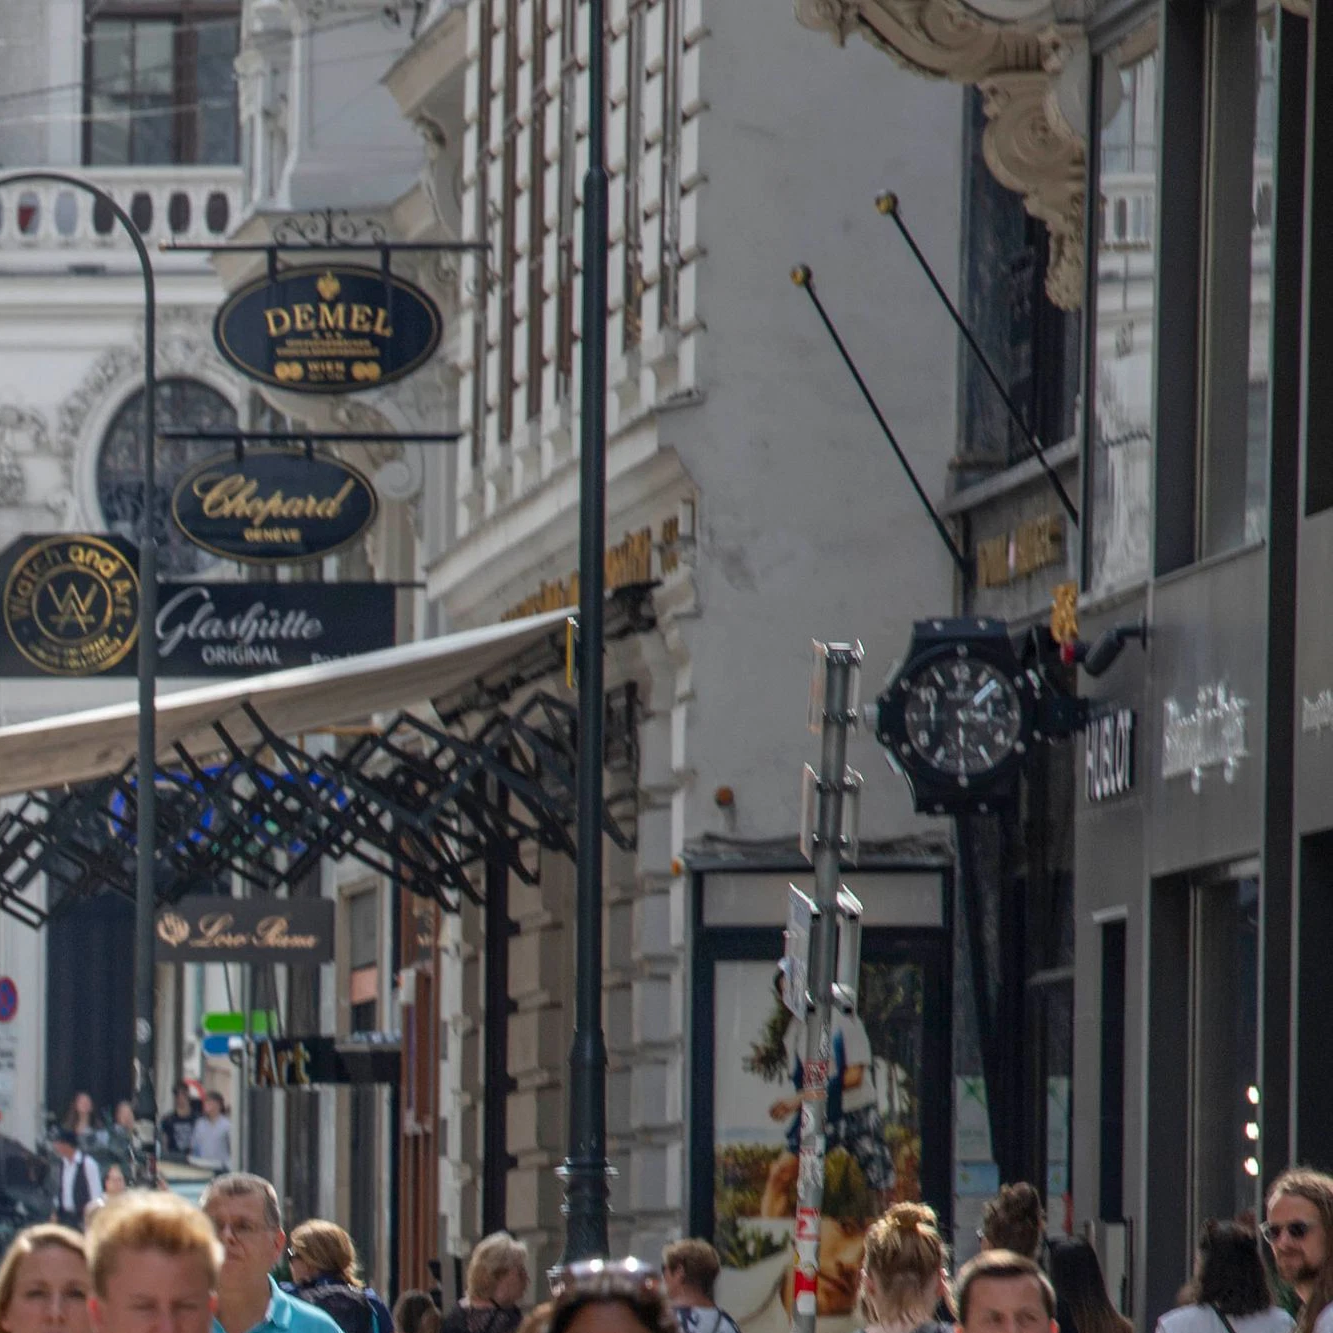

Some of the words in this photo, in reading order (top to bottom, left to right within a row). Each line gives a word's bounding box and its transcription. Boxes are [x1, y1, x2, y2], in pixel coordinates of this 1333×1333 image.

[264, 302, 393, 337] DEMEL
[193, 472, 356, 526] Chopard
[68, 545, 121, 578] and
[201, 646, 281, 666] ORIGINAL
